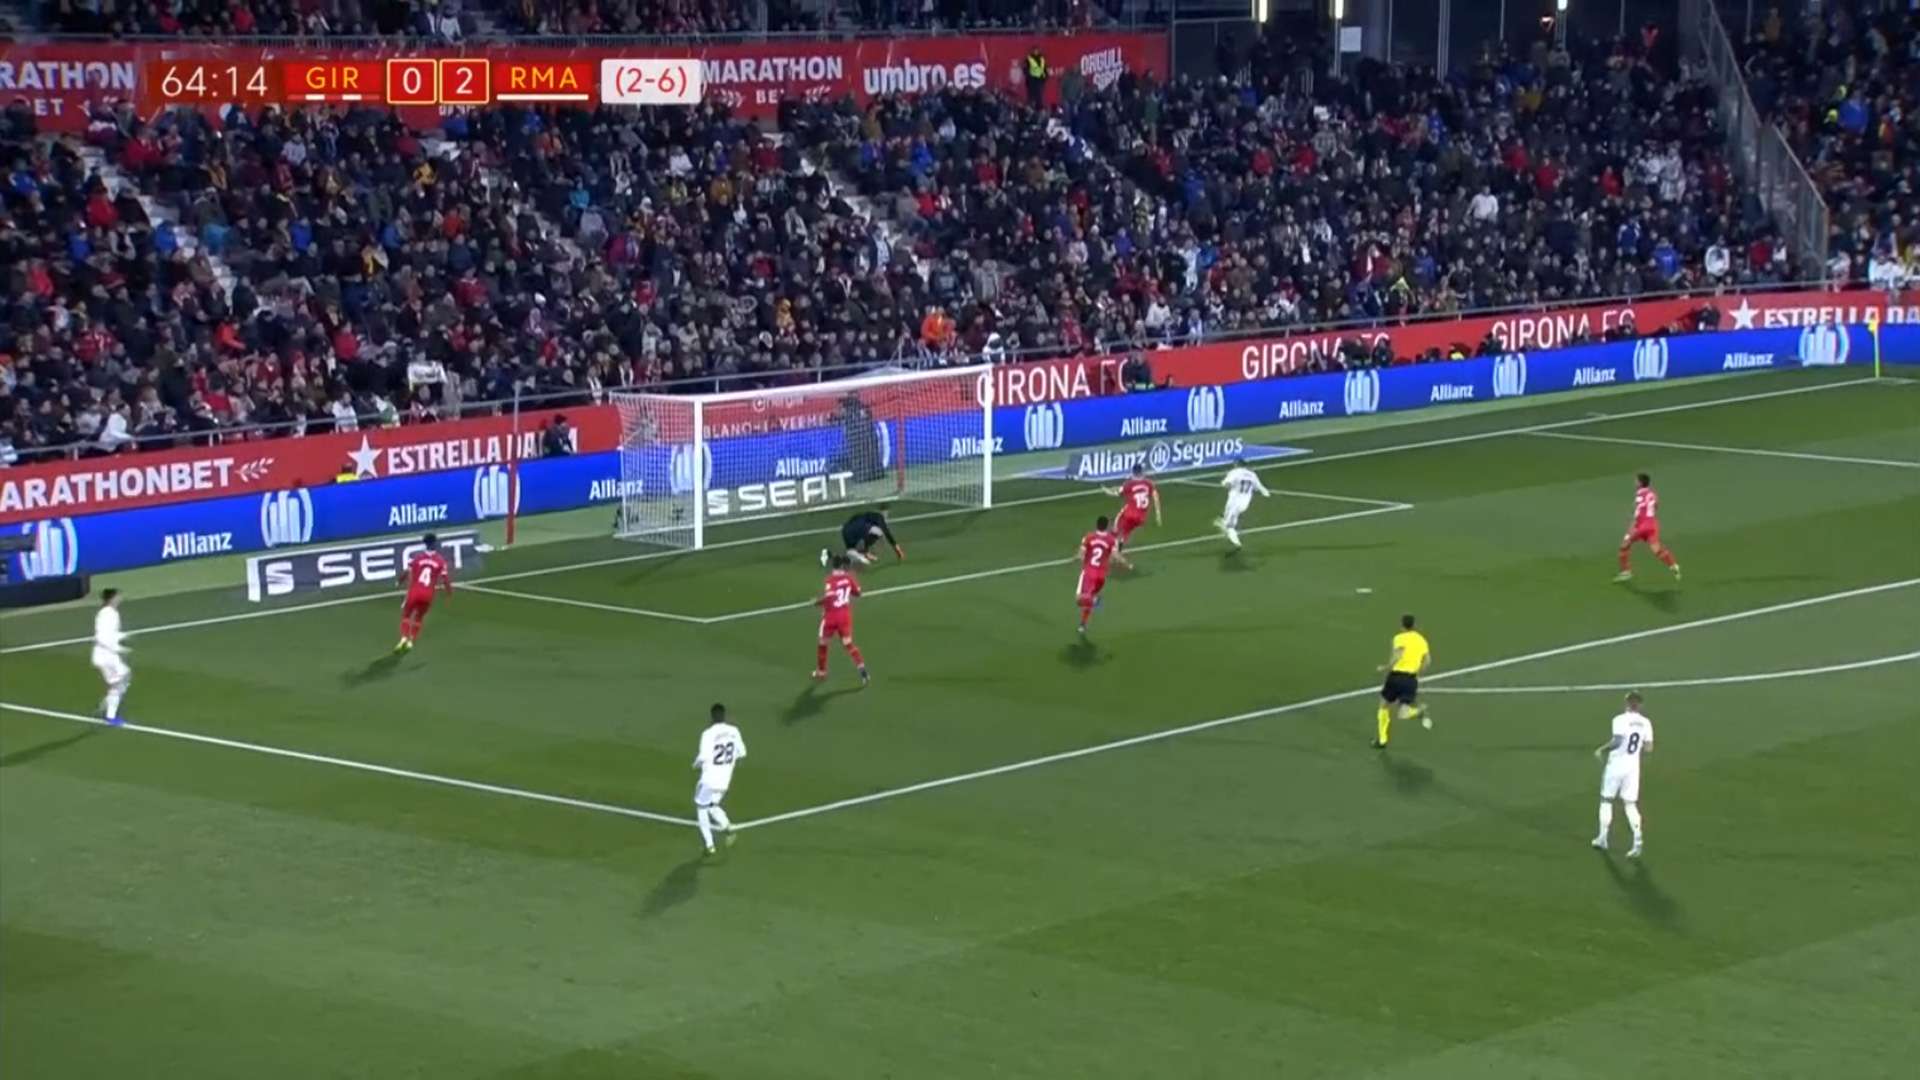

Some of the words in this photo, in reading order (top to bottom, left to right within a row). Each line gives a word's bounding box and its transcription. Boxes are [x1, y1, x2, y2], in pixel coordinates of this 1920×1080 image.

[701, 56, 843, 84] MARATHON
[863, 57, 986, 95] umbro.es
[33, 98, 63, 116] ET
[755, 89, 785, 104] BE
[1723, 352, 1774, 369] Allianz
[977, 363, 1091, 407] GIRONA
[1573, 366, 1616, 386] Allianz
[1431, 383, 1475, 401] Allianz
[1279, 398, 1324, 418] Allianz
[1121, 416, 1168, 437] Allianz
[387, 436, 502, 474] ESTRELLA
[952, 437, 1004, 458] Allianz
[1078, 449, 1147, 477] Allianz
[1171, 437, 1243, 465] Seguros
[776, 456, 827, 478] Allianz
[589, 478, 645, 501] Allianz
[738, 471, 853, 511] SEAT
[388, 503, 448, 526] Allianz
[162, 532, 233, 559] Allianz
[1090, 548, 1103, 566] 2
[418, 566, 432, 587] 4
[713, 741, 734, 766] 28
[1627, 732, 1640, 755] 8
